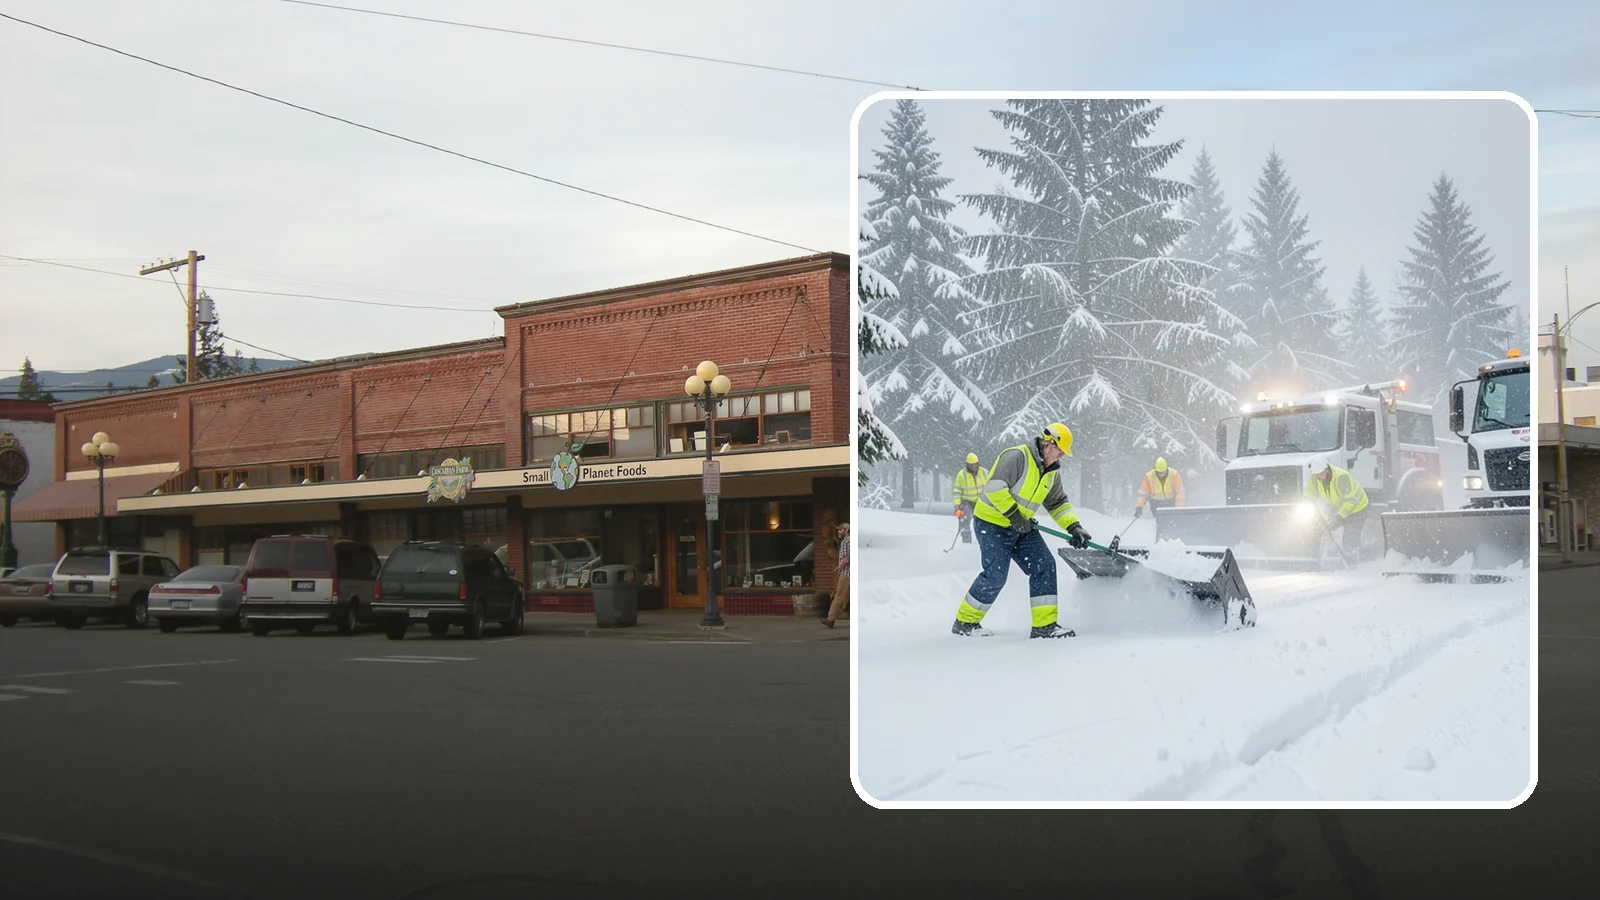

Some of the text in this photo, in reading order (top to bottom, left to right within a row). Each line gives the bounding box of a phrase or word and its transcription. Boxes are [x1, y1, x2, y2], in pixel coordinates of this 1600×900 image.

[523, 464, 647, 483] Small Planet Foods
